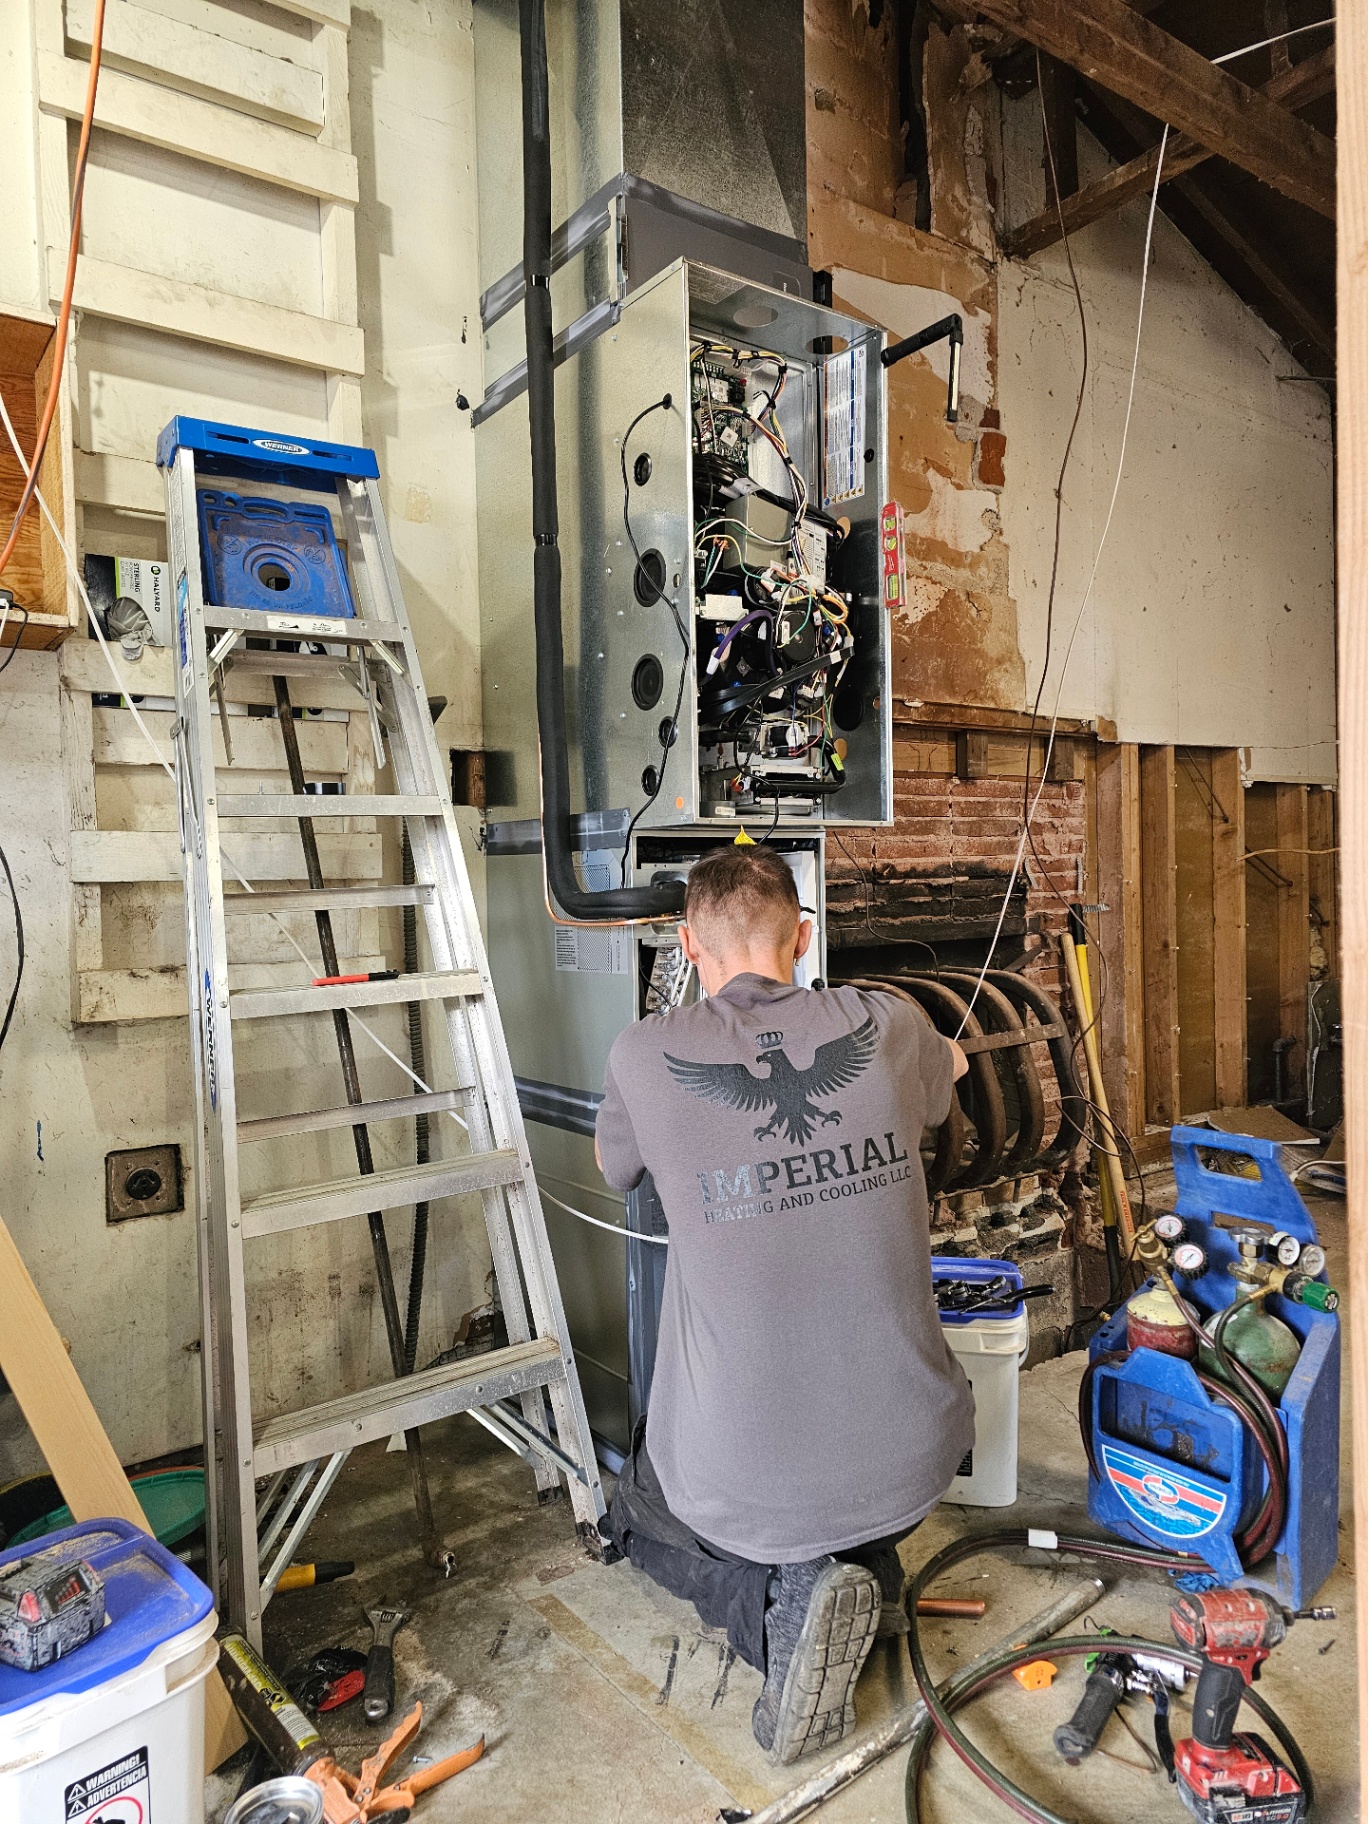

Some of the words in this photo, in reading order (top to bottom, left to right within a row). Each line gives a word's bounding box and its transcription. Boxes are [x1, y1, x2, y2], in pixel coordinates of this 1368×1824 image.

[264, 441, 301, 453] WERNER
[133, 562, 141, 593] STERLING
[153, 577, 161, 613] HALYARD
[206, 998, 216, 1088] WERNER
[696, 1131, 908, 1205] IMPERIAL
[704, 1200, 774, 1224] HEATING
[780, 1192, 814, 1211] AND
[819, 1175, 888, 1202] COOLING
[890, 1166, 912, 1183] LLC
[85, 1753, 141, 1792] WARNING!
[86, 1765, 147, 1808] ADVERTENCIA
